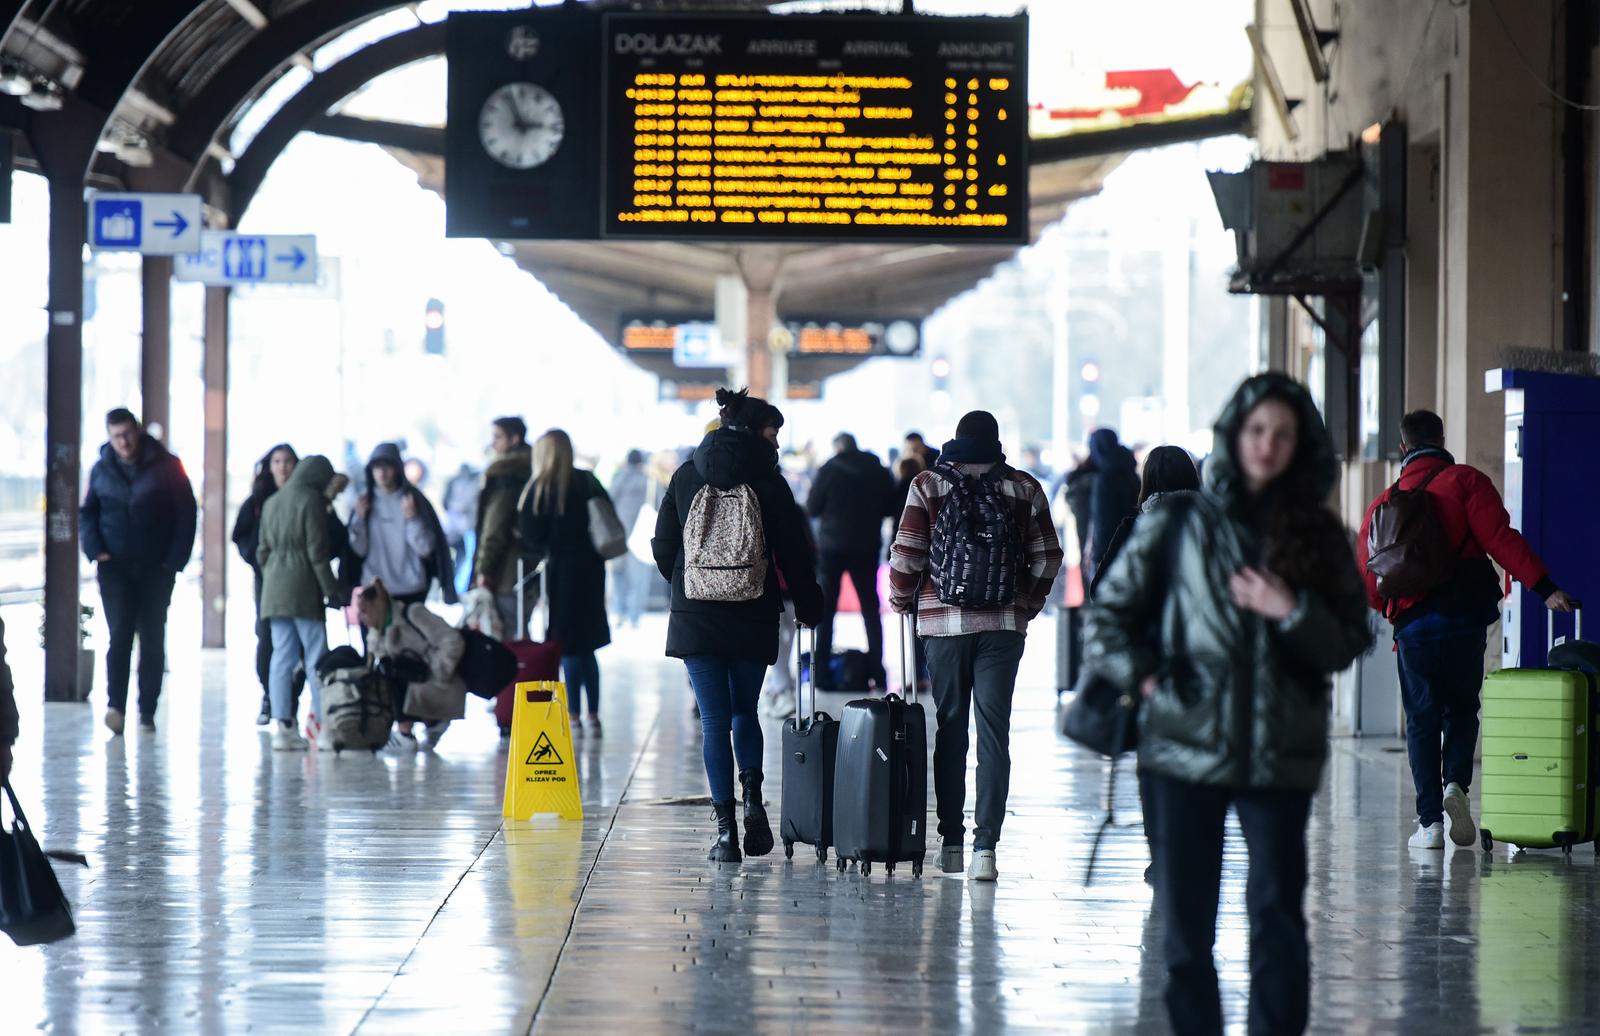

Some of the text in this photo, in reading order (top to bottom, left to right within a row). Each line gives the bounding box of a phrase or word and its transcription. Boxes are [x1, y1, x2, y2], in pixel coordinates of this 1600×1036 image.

[615, 32, 723, 55] DOLAZAK
[842, 40, 912, 58] ARRIVAL
[936, 40, 1015, 58] ANKUNFT
